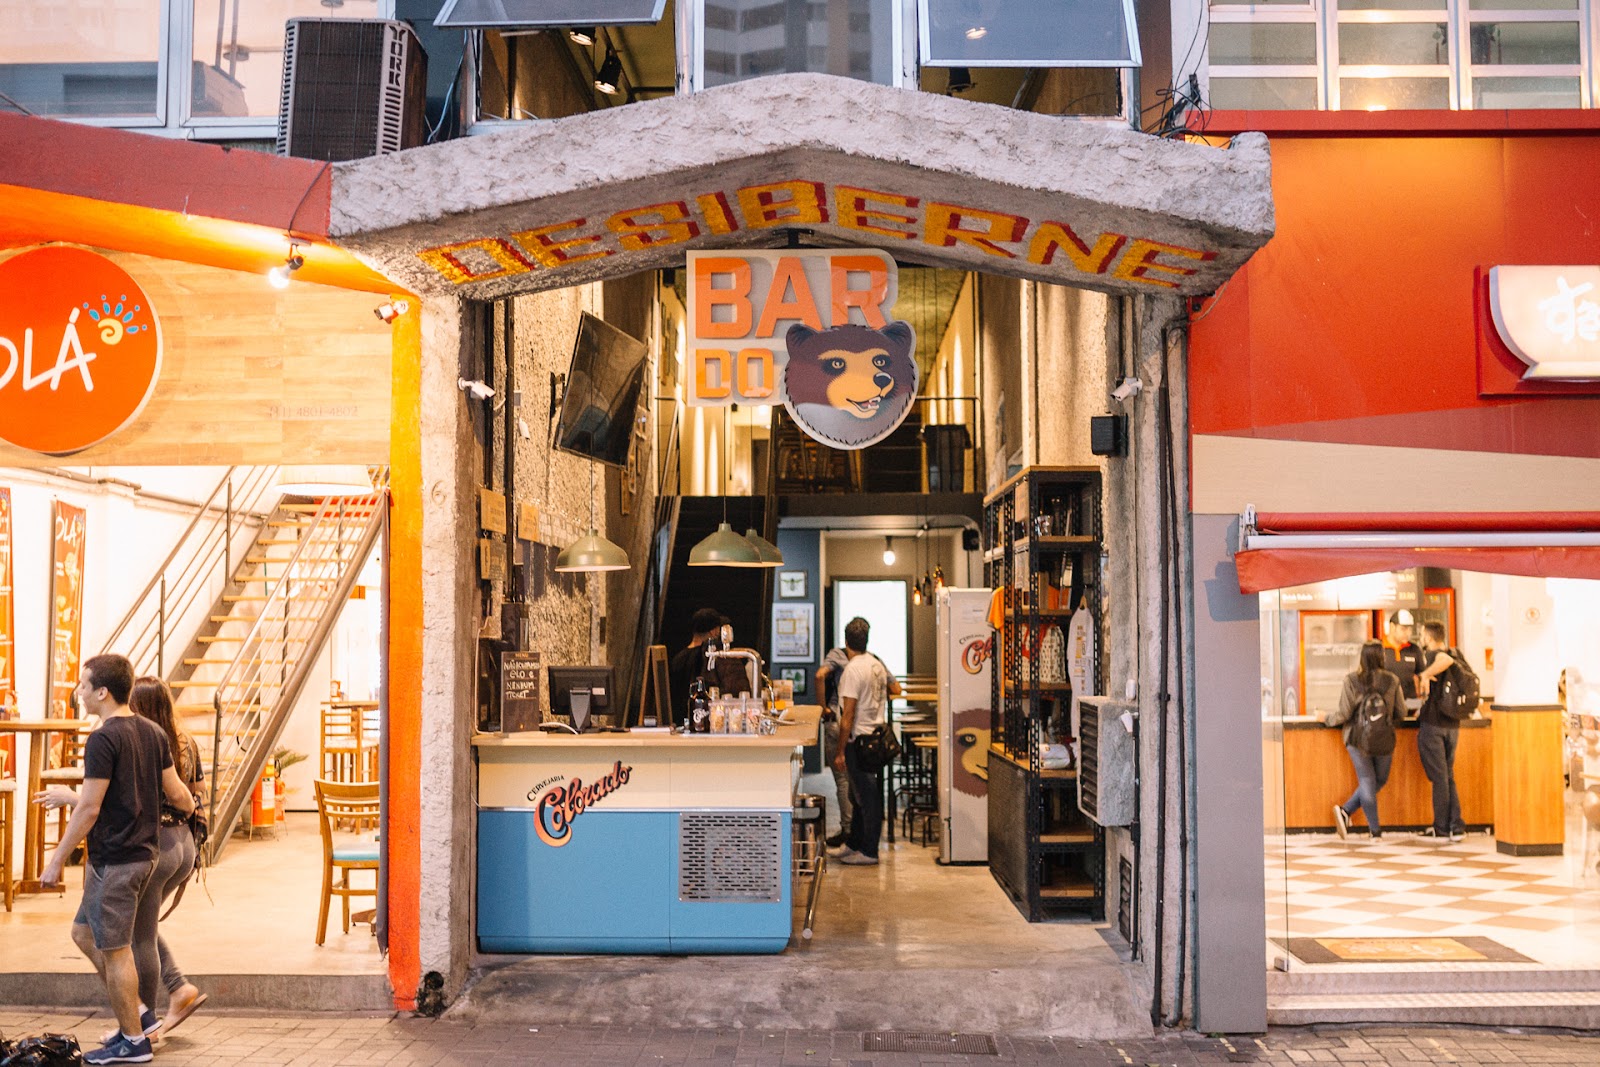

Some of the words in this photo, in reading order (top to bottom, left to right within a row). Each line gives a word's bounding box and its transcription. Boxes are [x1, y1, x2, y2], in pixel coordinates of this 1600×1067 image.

[386, 25, 407, 87] YORK
[695, 256, 889, 339] BAR
[696, 348, 775, 399] DO
[526, 774, 565, 802] CERVEJARIA
[533, 760, 633, 848] Colorado
